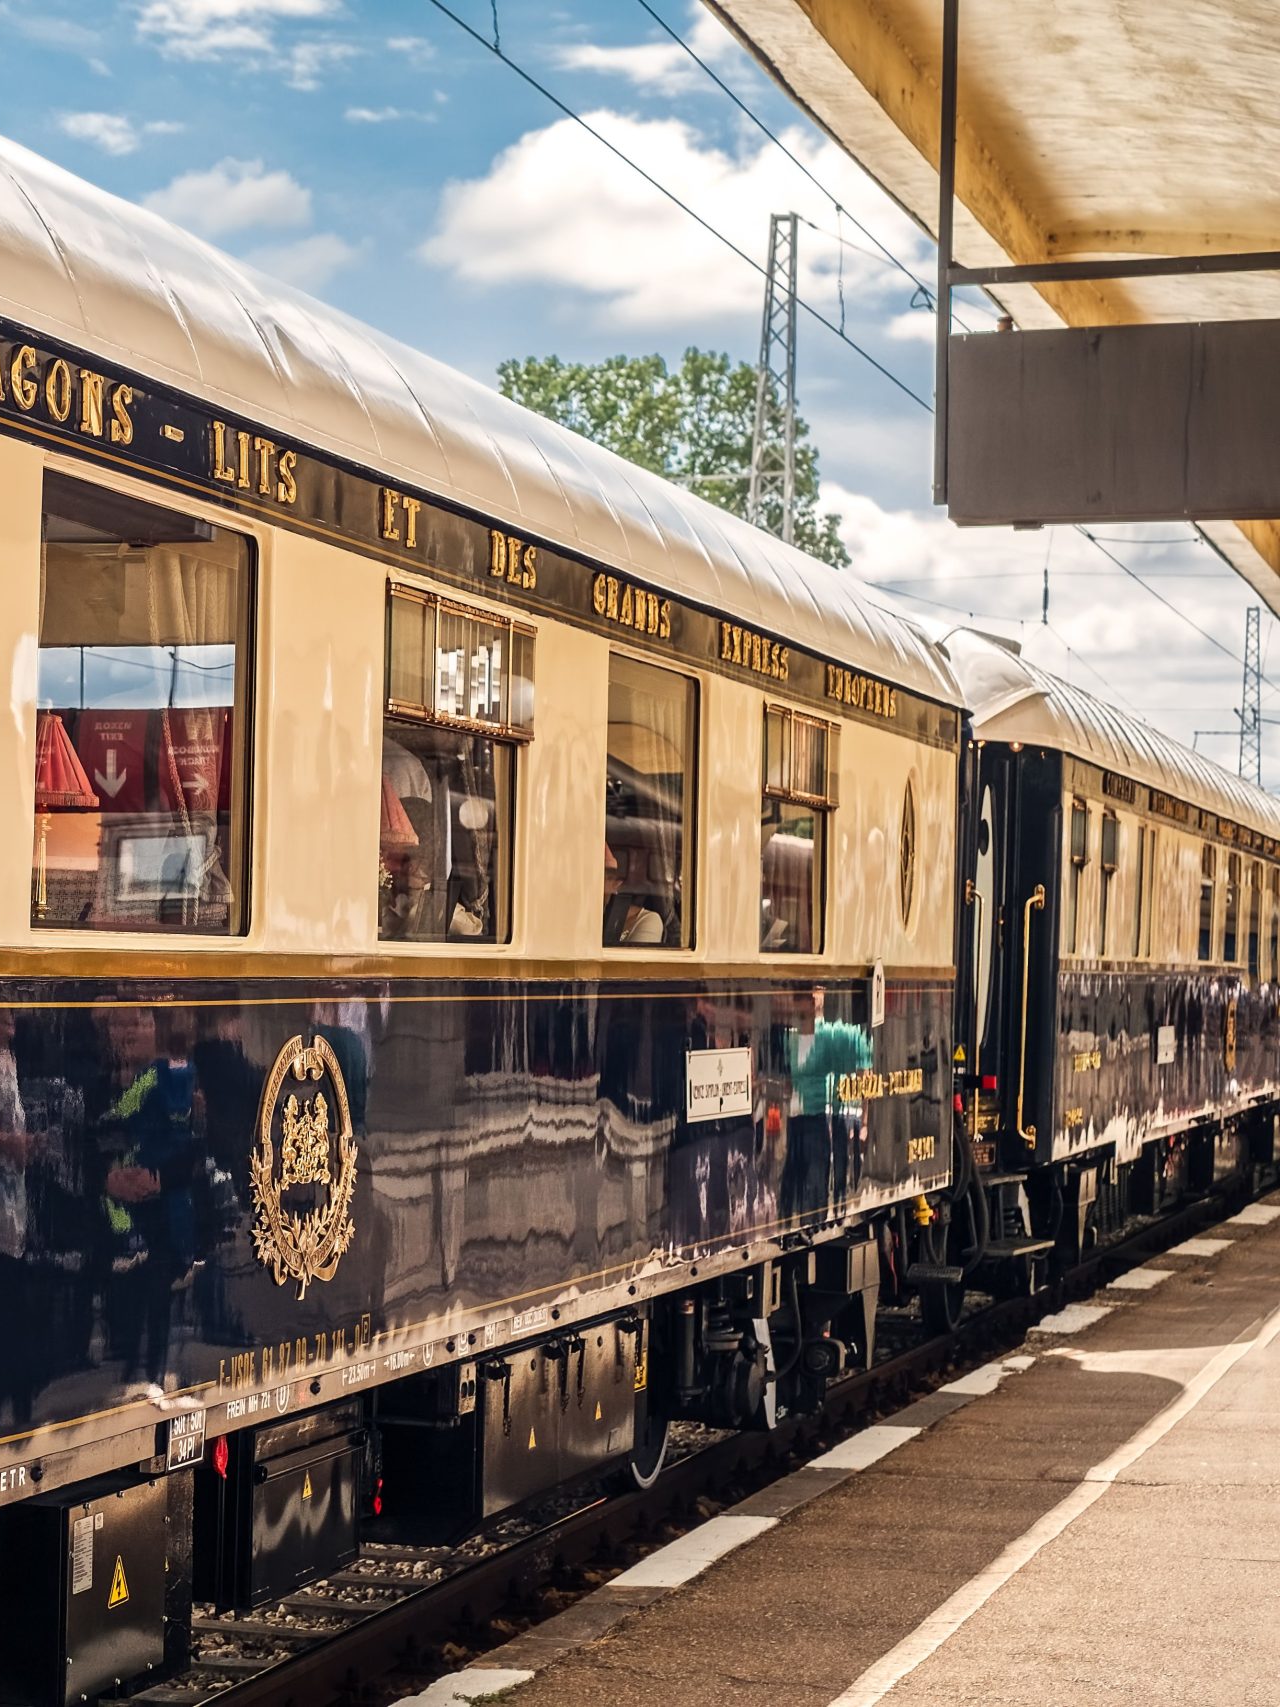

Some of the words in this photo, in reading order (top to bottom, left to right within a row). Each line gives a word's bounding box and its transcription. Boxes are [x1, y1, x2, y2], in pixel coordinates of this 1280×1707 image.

[212, 420, 297, 504] LITS
[382, 487, 421, 549] ET
[489, 529, 537, 590] DES
[593, 572, 671, 638] GRANDS
[721, 621, 789, 681] EXPRESS
[279, 1341, 291, 1379] 87
[226, 1399, 245, 1420] FREIN
[248, 1394, 258, 1413] MH
